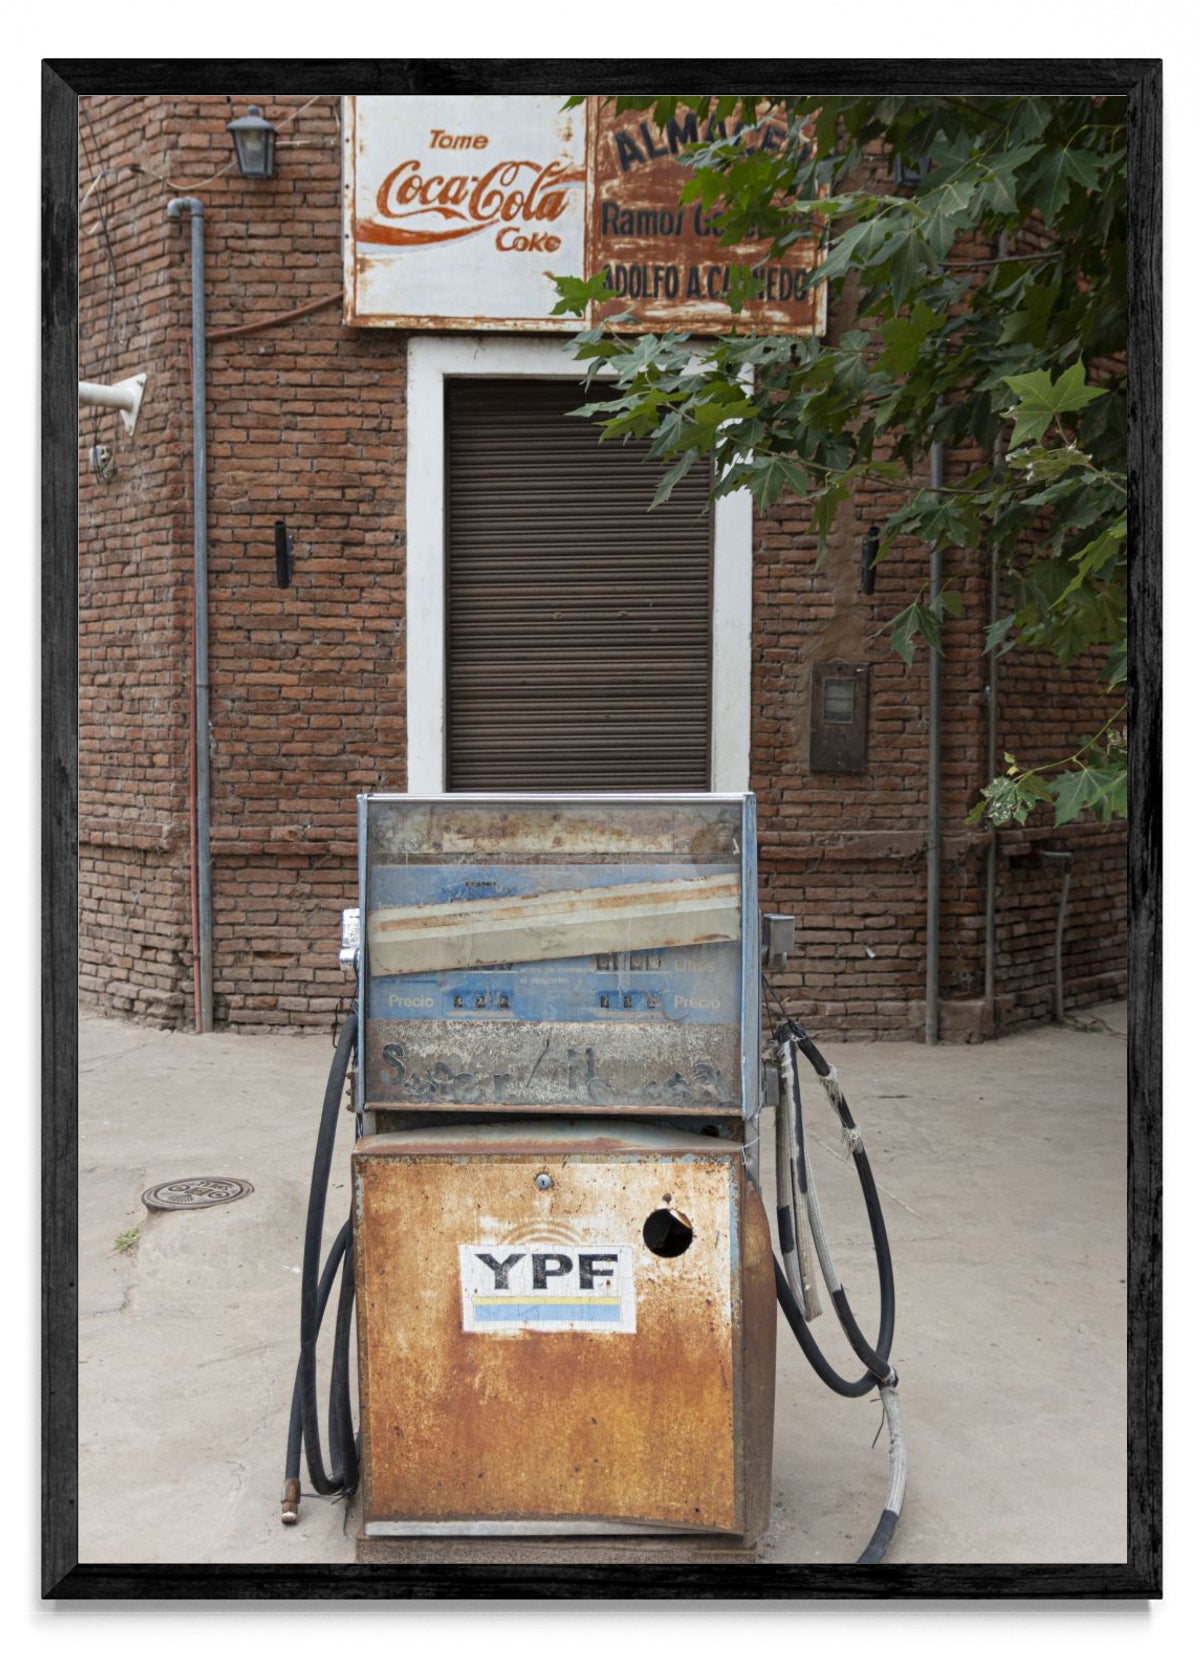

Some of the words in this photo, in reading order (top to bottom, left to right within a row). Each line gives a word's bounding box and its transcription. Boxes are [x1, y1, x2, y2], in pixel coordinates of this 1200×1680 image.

[429, 129, 489, 150] Tome
[376, 159, 570, 222] Coca-Cola
[495, 226, 562, 253] Coke
[602, 264, 680, 299] ADOLFO
[388, 993, 435, 1009] Precio
[674, 993, 721, 1010] Precio
[475, 1253, 619, 1290] YPF
